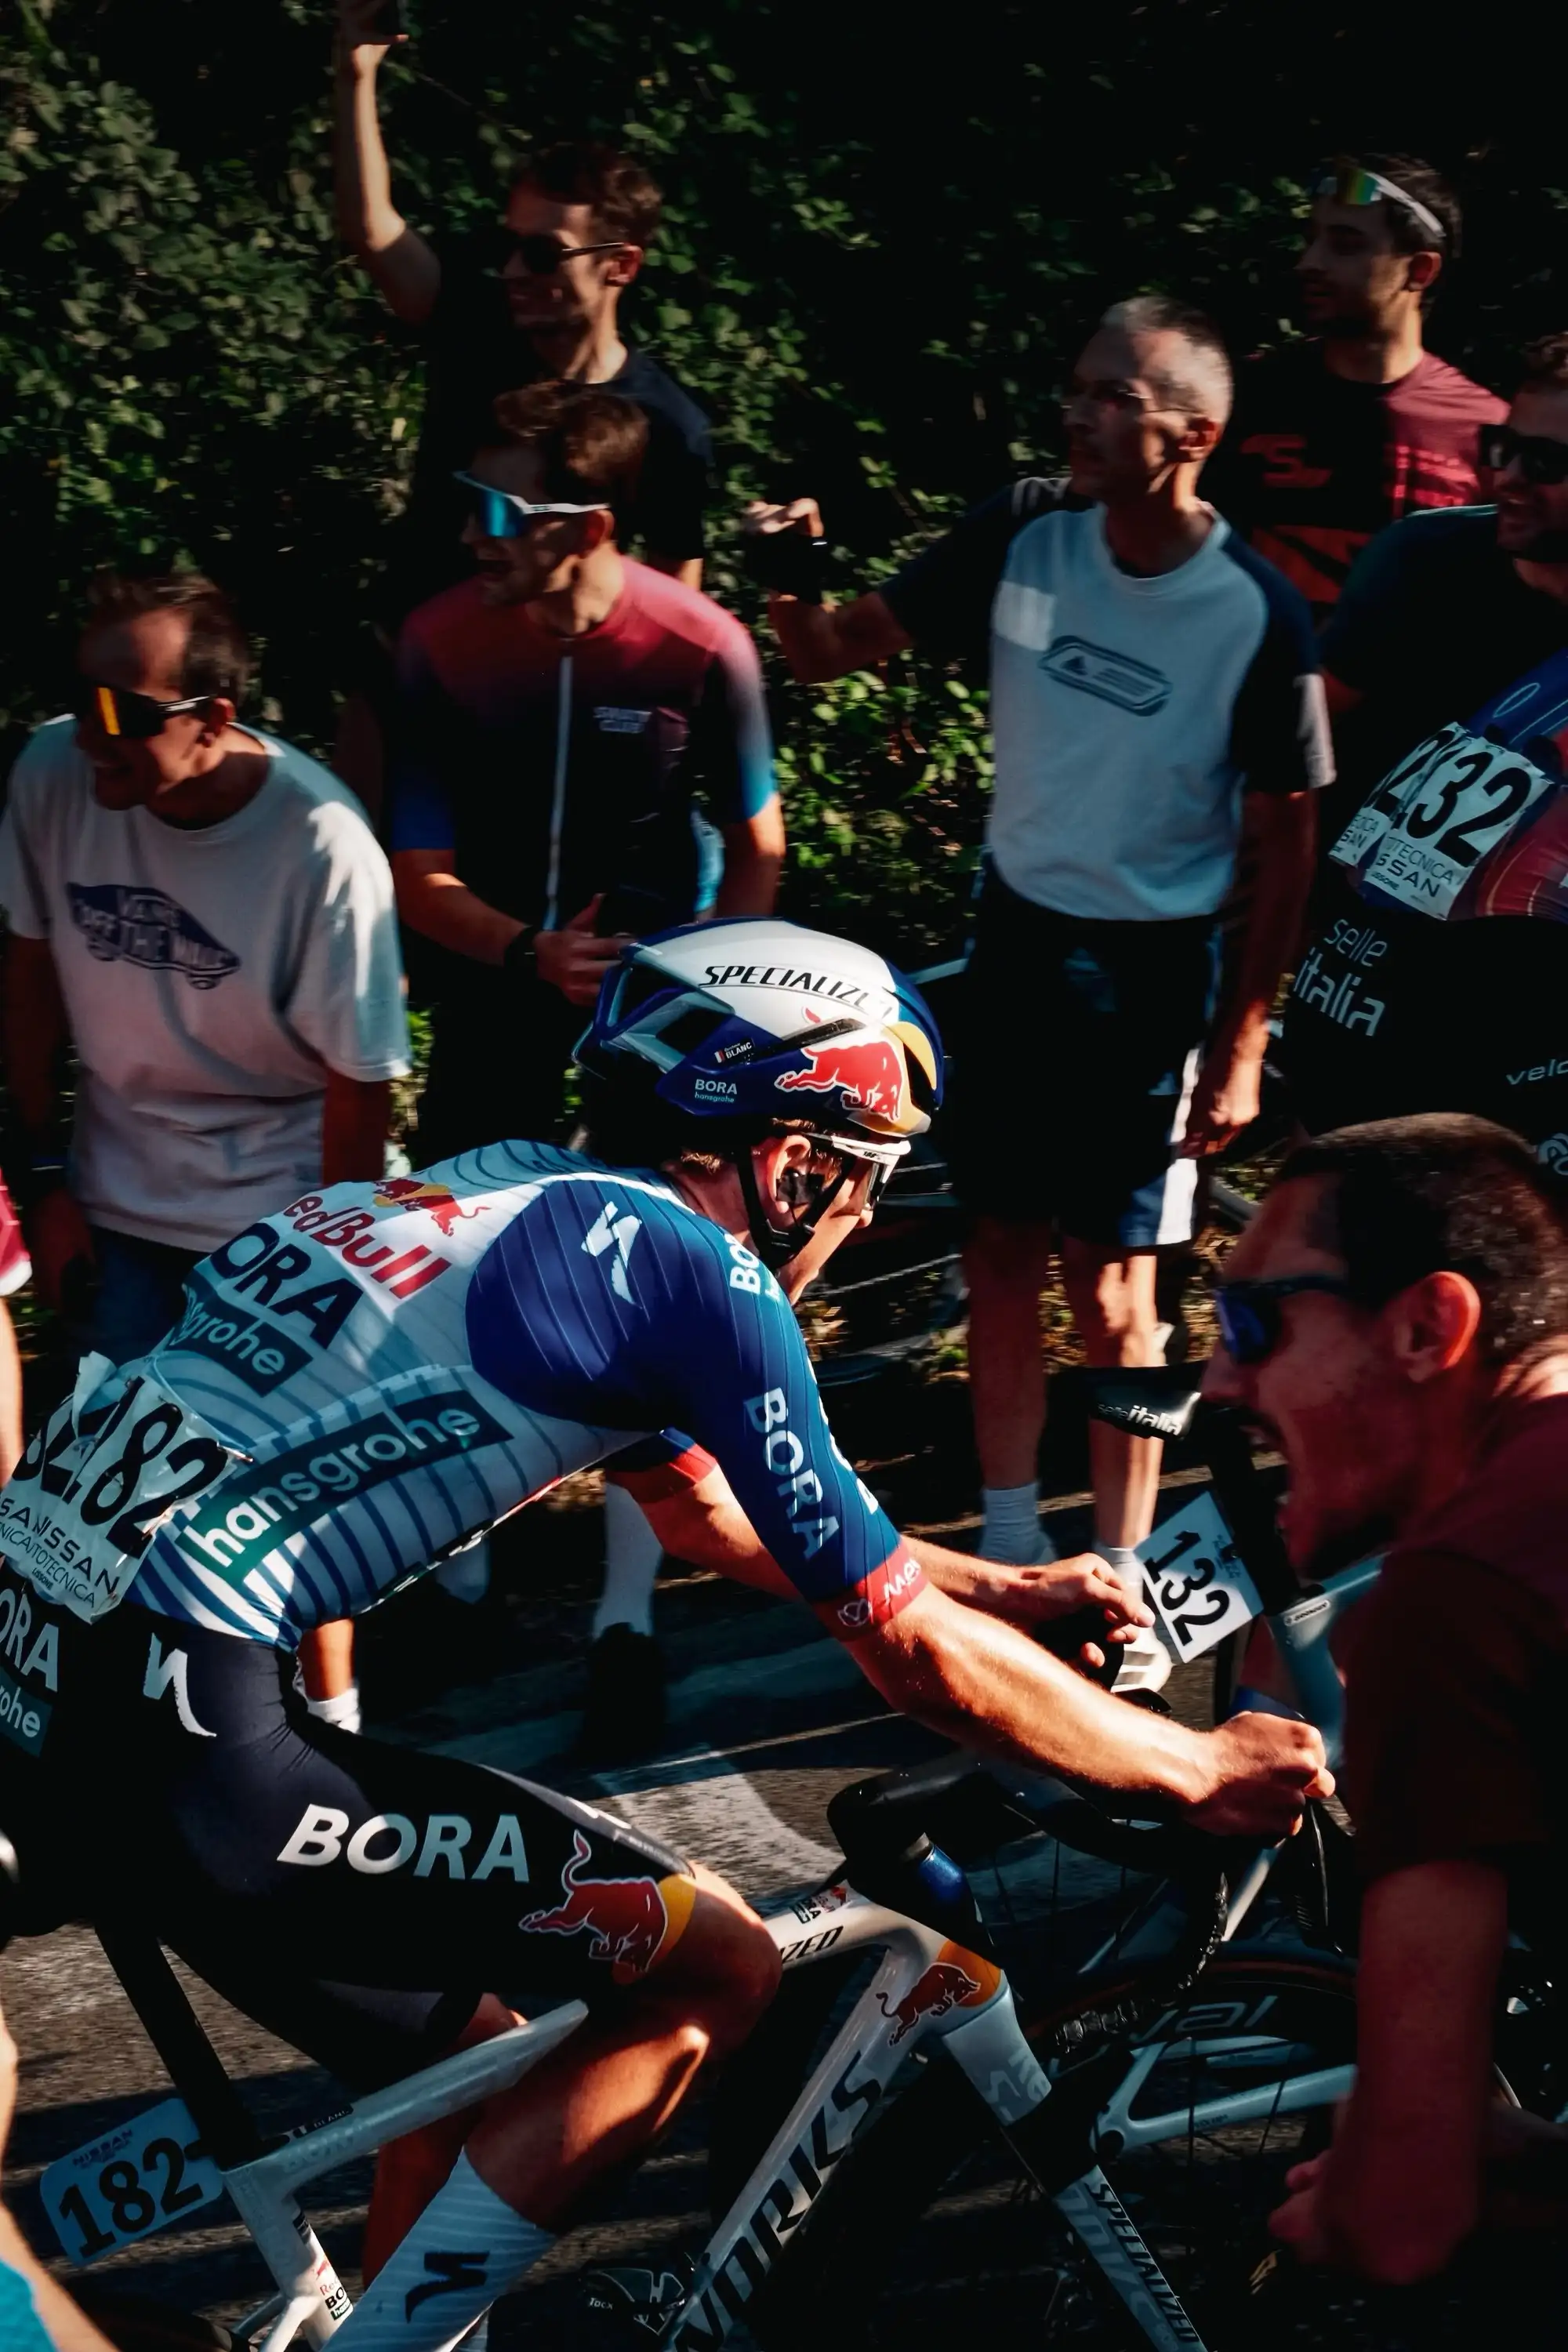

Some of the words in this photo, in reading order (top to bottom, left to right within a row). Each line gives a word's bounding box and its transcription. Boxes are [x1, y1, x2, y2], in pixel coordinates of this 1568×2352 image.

[1293, 946, 1386, 1037] italia
[1323, 918, 1388, 967] selle
[695, 1078, 738, 1095] BORA
[725, 1041, 753, 1059] BLANC
[209, 1221, 363, 1349] ORA
[184, 1408, 481, 1568] hansgrohe
[743, 1386, 840, 1563] BORA
[0, 1588, 60, 1693] ORA
[1145, 1530, 1230, 1646] 132
[276, 1802, 530, 1882] BORA
[59, 2137, 204, 2259] 182
